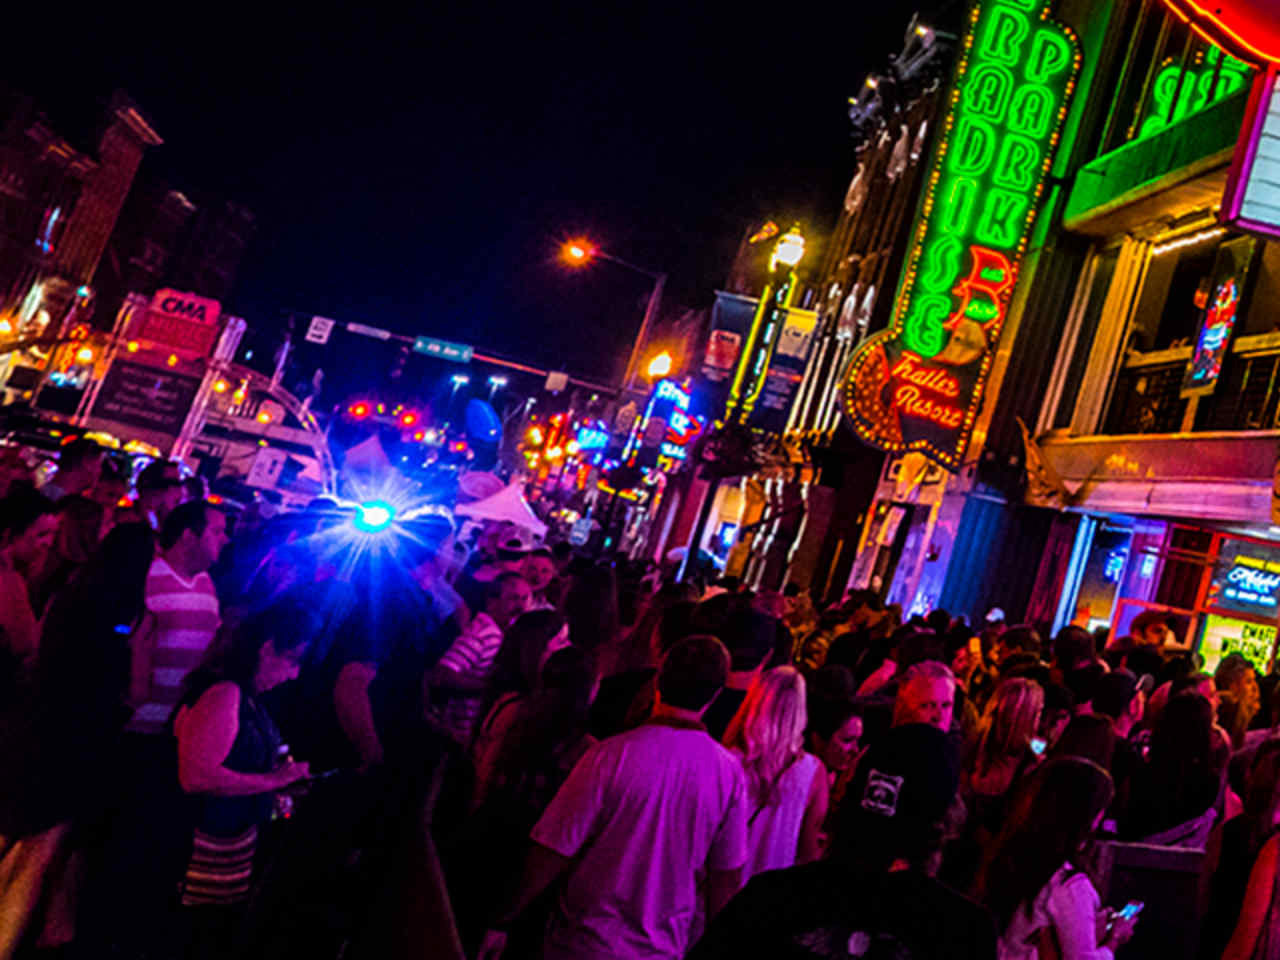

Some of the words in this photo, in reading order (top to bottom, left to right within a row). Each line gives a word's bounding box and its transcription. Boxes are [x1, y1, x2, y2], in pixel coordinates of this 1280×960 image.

[974, 28, 1072, 250] PARK
[161, 297, 208, 322] CMA
[896, 385, 963, 429] Resort
